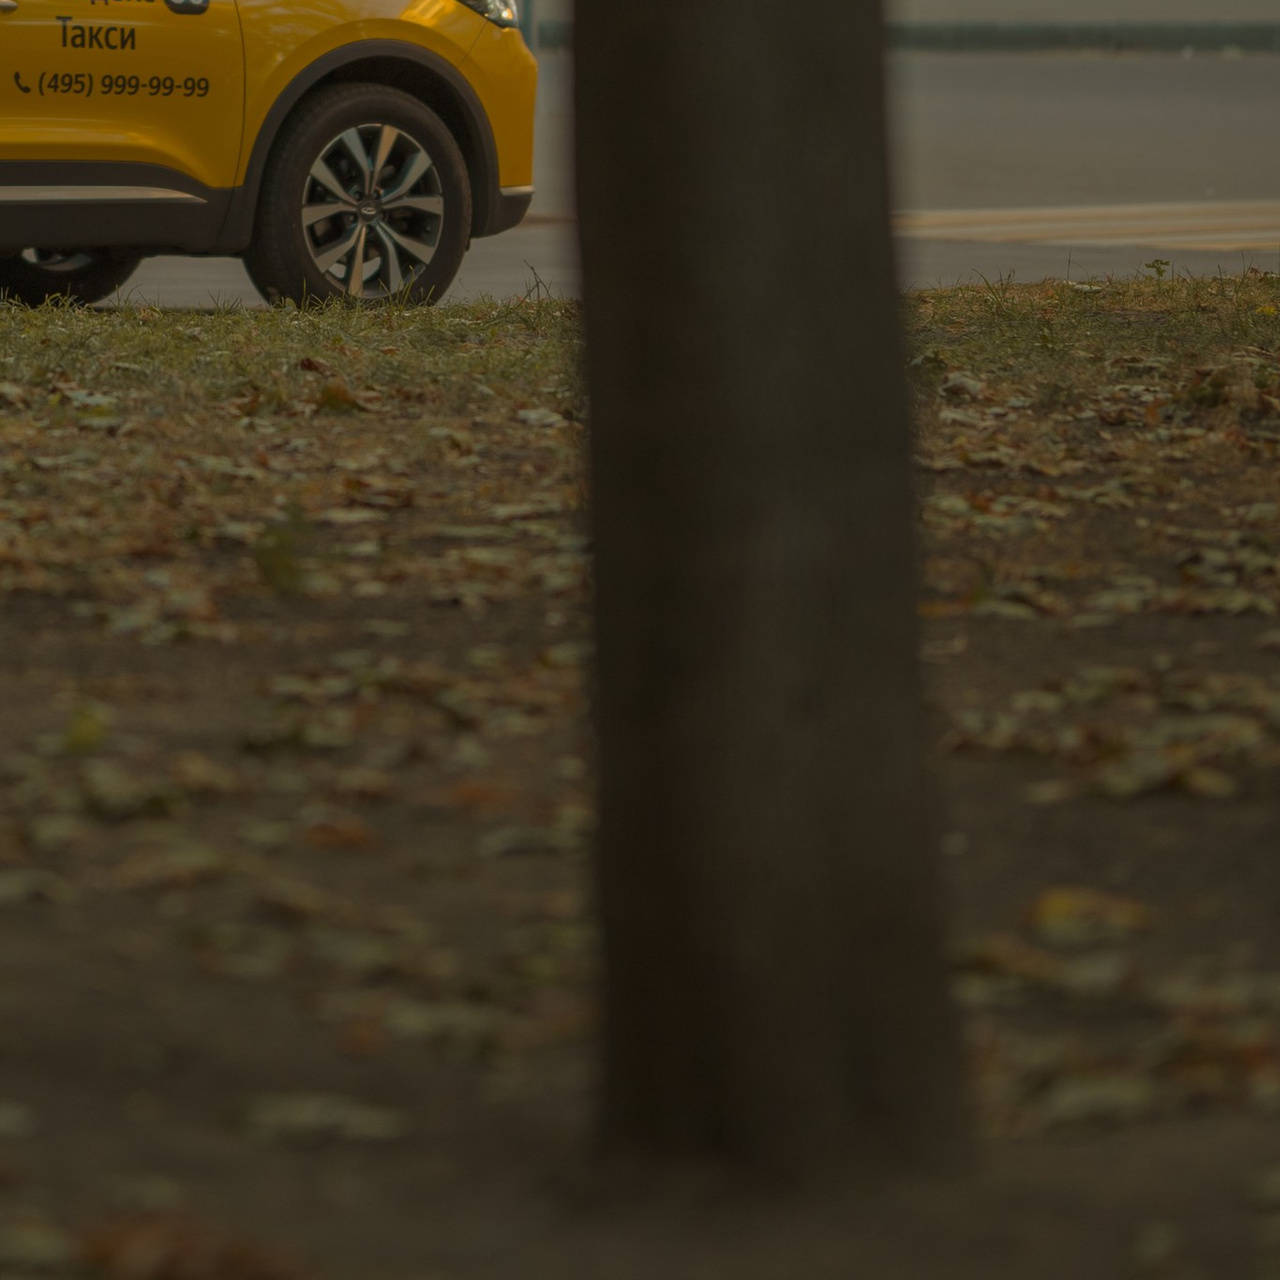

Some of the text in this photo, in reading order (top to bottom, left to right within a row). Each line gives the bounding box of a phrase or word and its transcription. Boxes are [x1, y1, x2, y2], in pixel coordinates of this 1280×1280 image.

[56, 16, 136, 50] Такси
[38, 72, 209, 97] (495) 999-99-99
